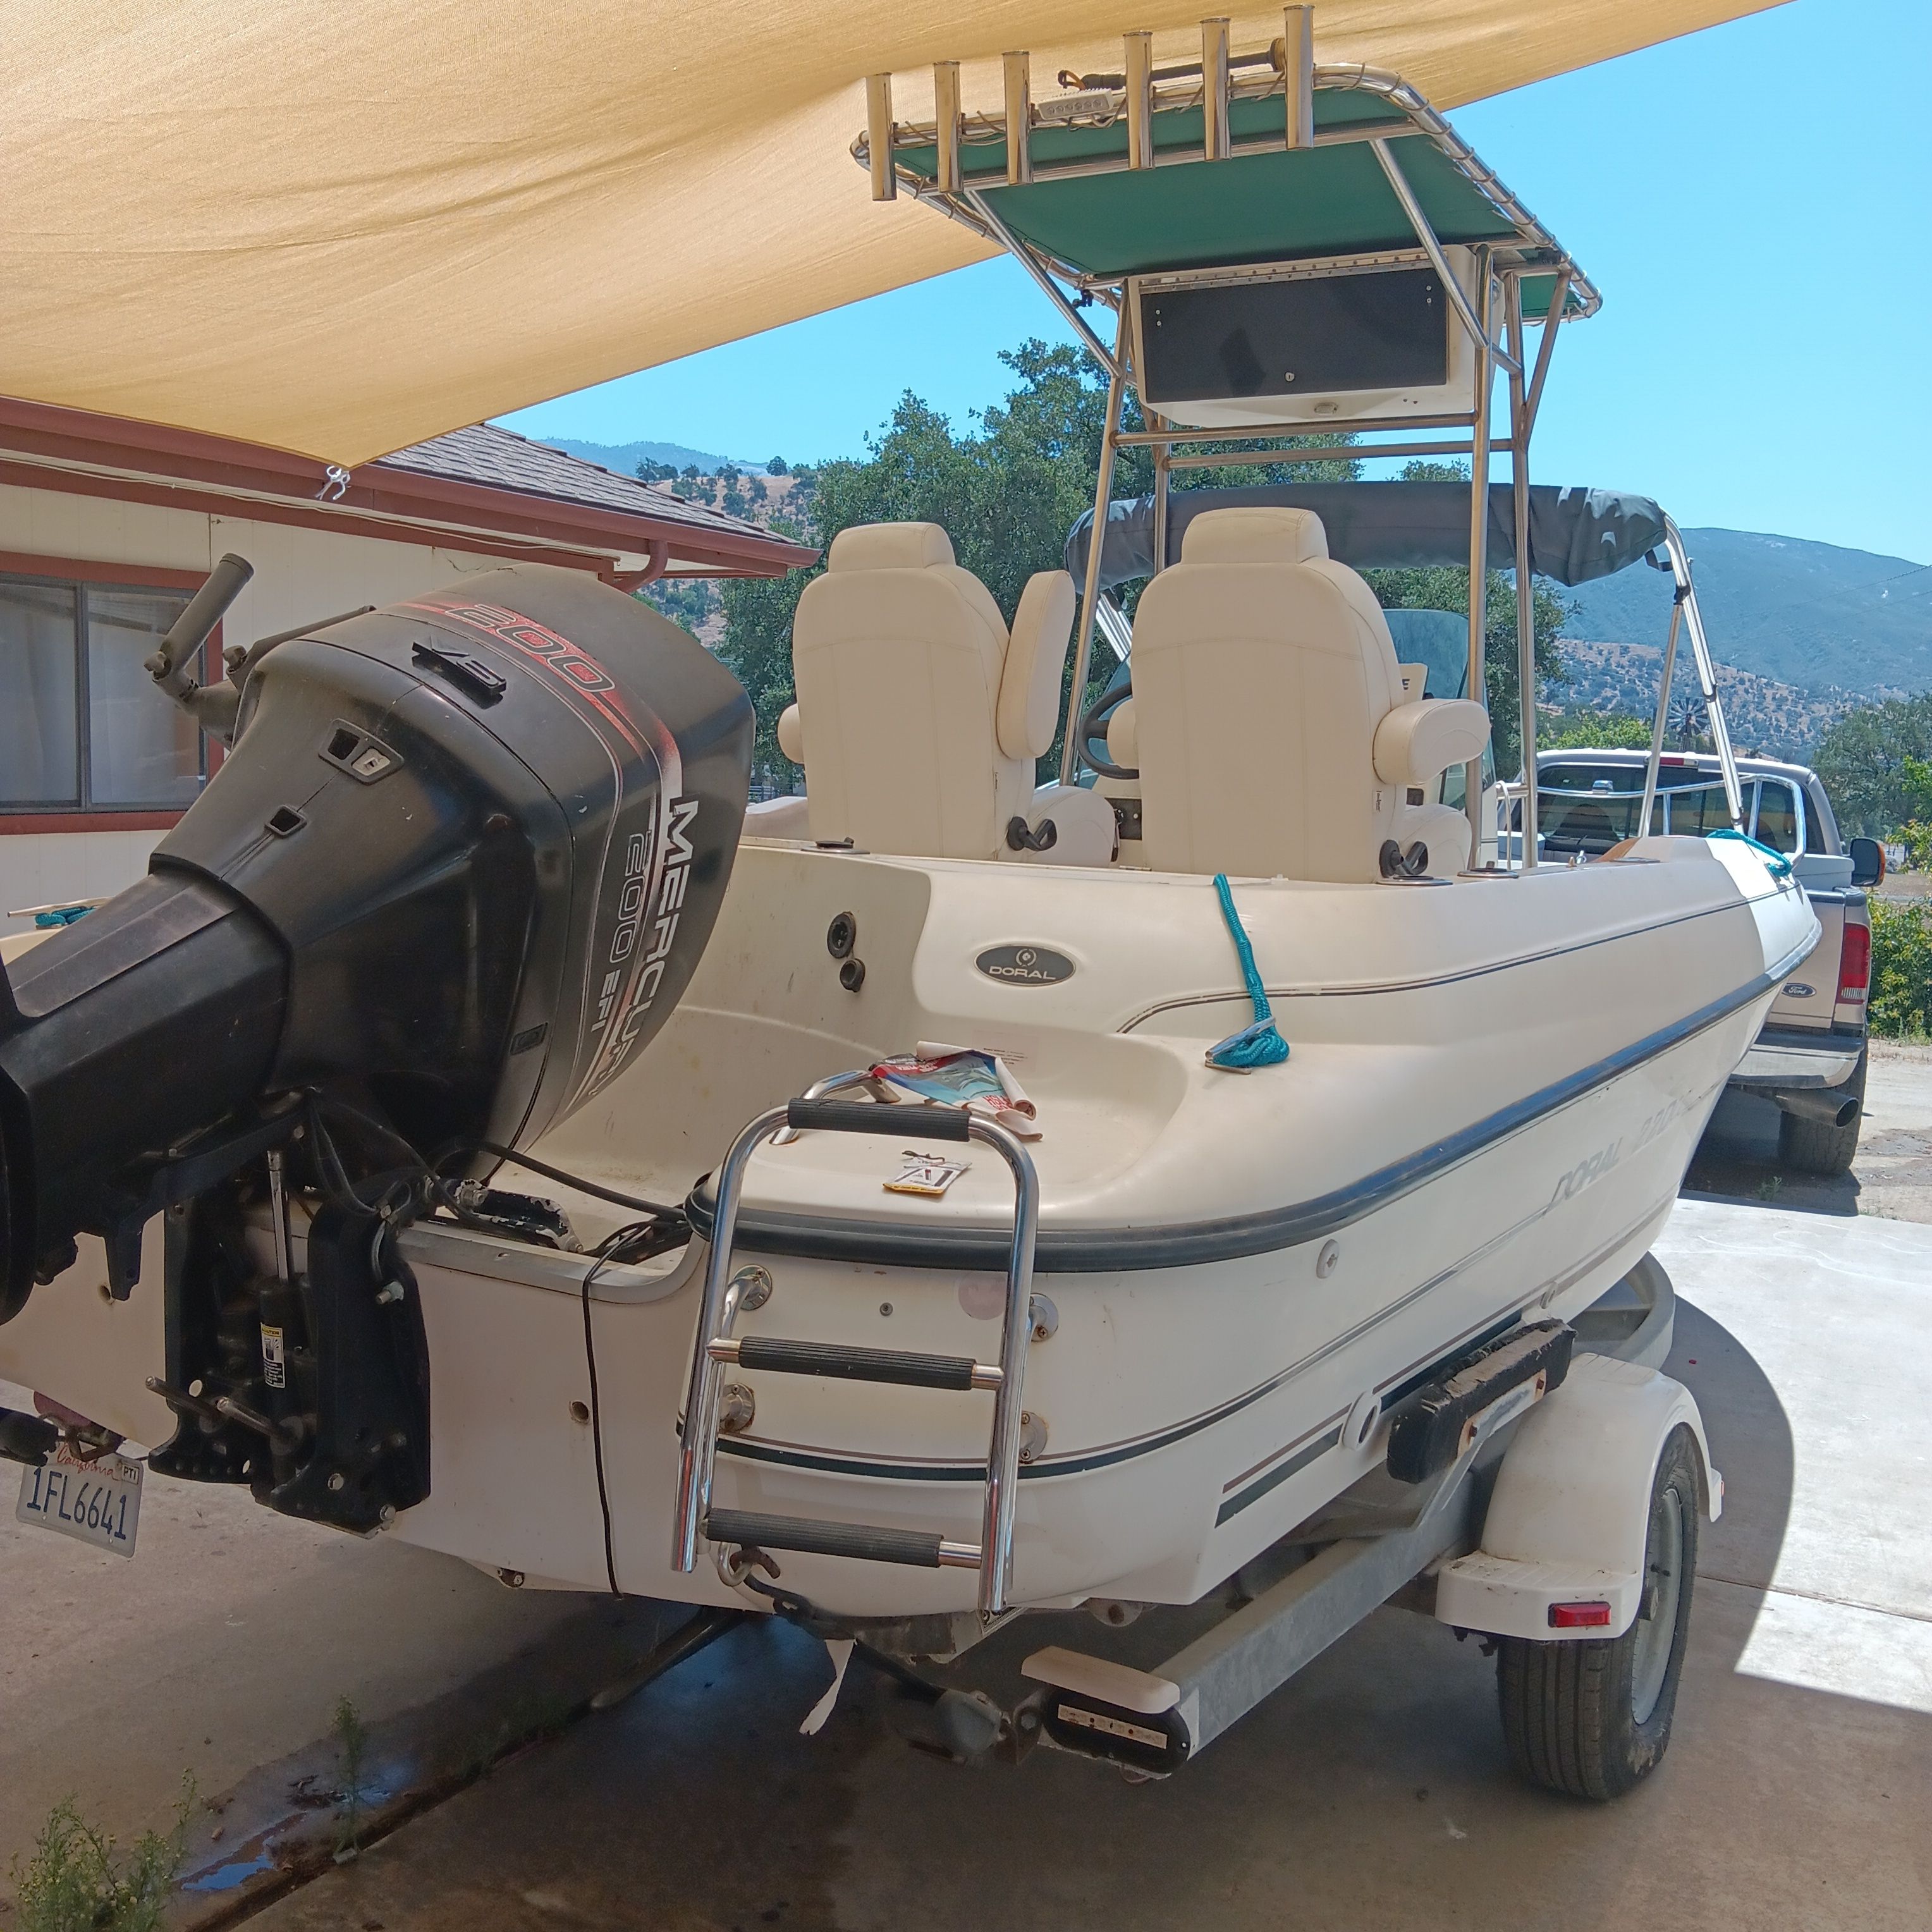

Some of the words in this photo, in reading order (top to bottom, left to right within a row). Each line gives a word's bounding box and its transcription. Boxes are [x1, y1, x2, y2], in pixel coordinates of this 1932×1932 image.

[444, 604, 615, 692] 200
[609, 829, 653, 963] 200
[587, 800, 699, 1097] MERCURY
[989, 965, 1056, 980] DORAL
[591, 969, 621, 1032] EFI
[1788, 986, 1807, 994] Ford
[27, 1466, 126, 1541] 1FL6641
[123, 1466, 137, 1480] PTI
